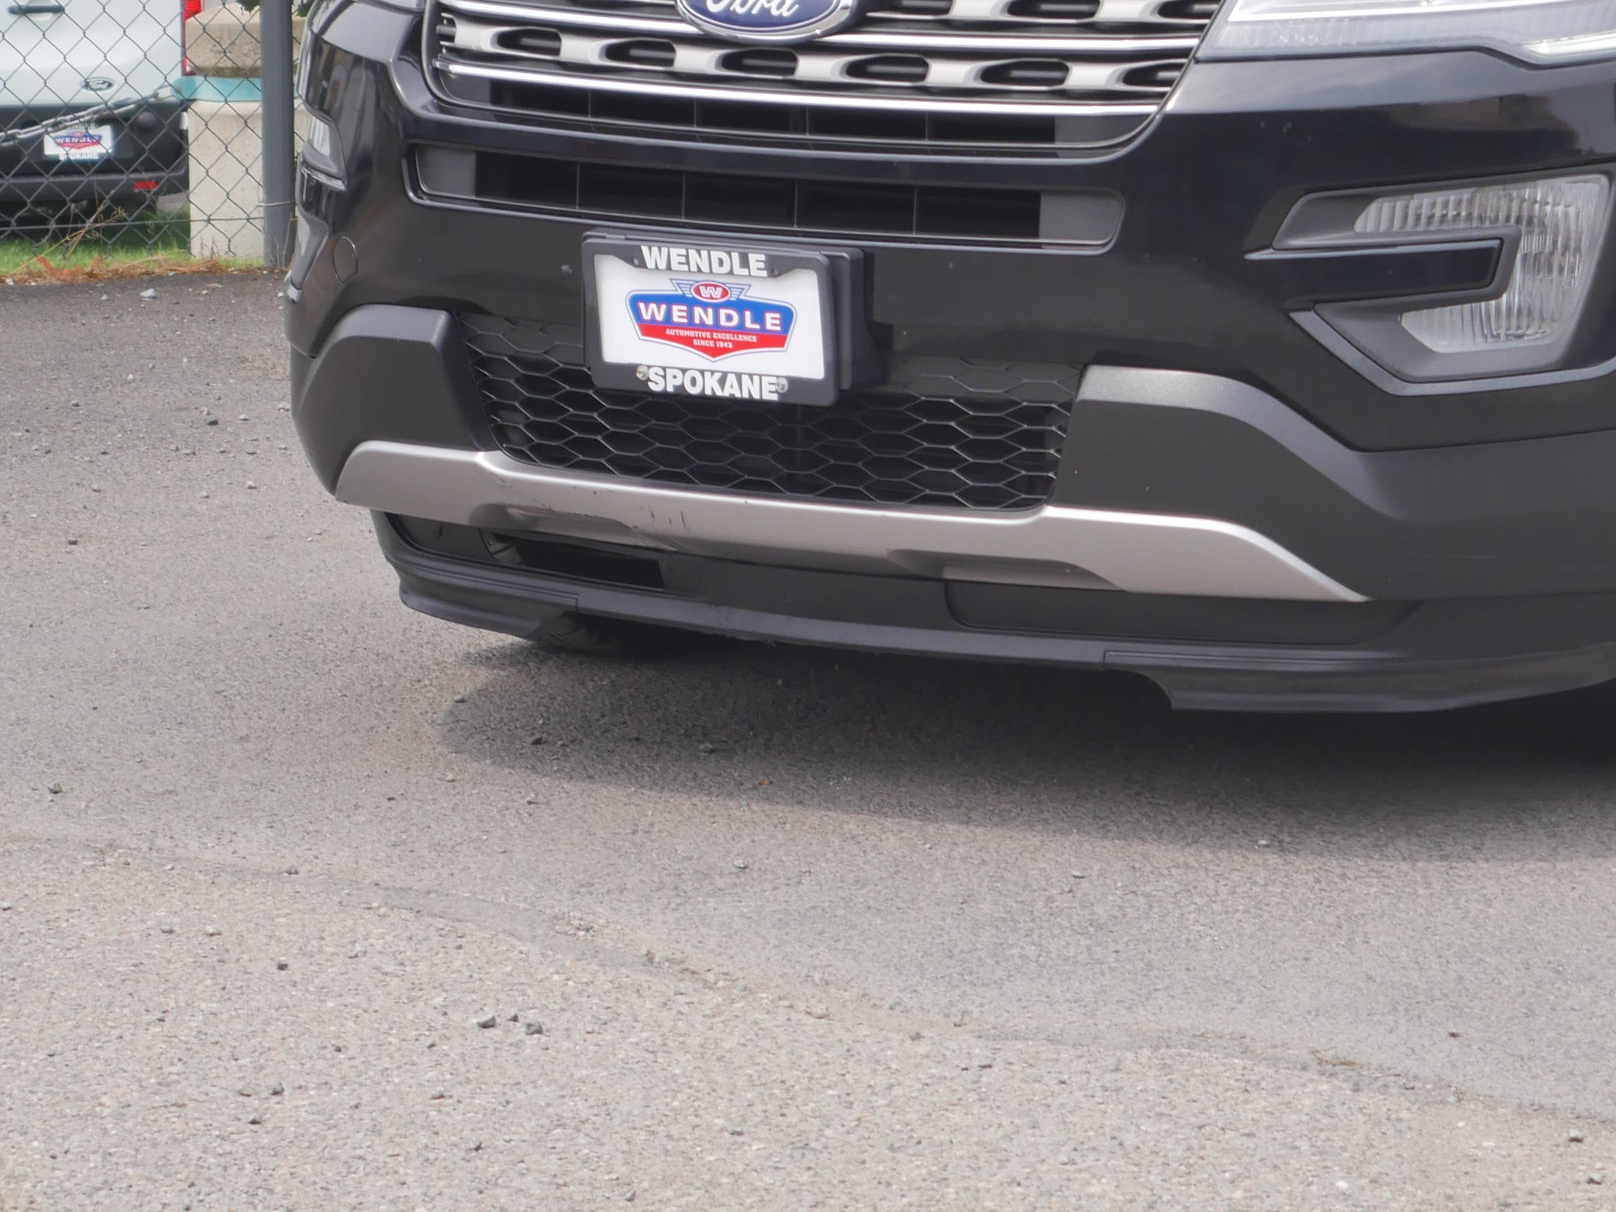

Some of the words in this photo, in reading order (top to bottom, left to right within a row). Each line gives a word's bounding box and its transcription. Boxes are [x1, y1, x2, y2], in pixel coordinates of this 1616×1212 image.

[640, 245, 768, 277] WENDLE
[637, 301, 783, 332] WENDLE
[665, 328, 712, 339] AUTOMOTIVE
[713, 332, 758, 343] EXCELLENCE
[693, 339, 714, 347] SINCE
[648, 366, 780, 401] SPOKANE
